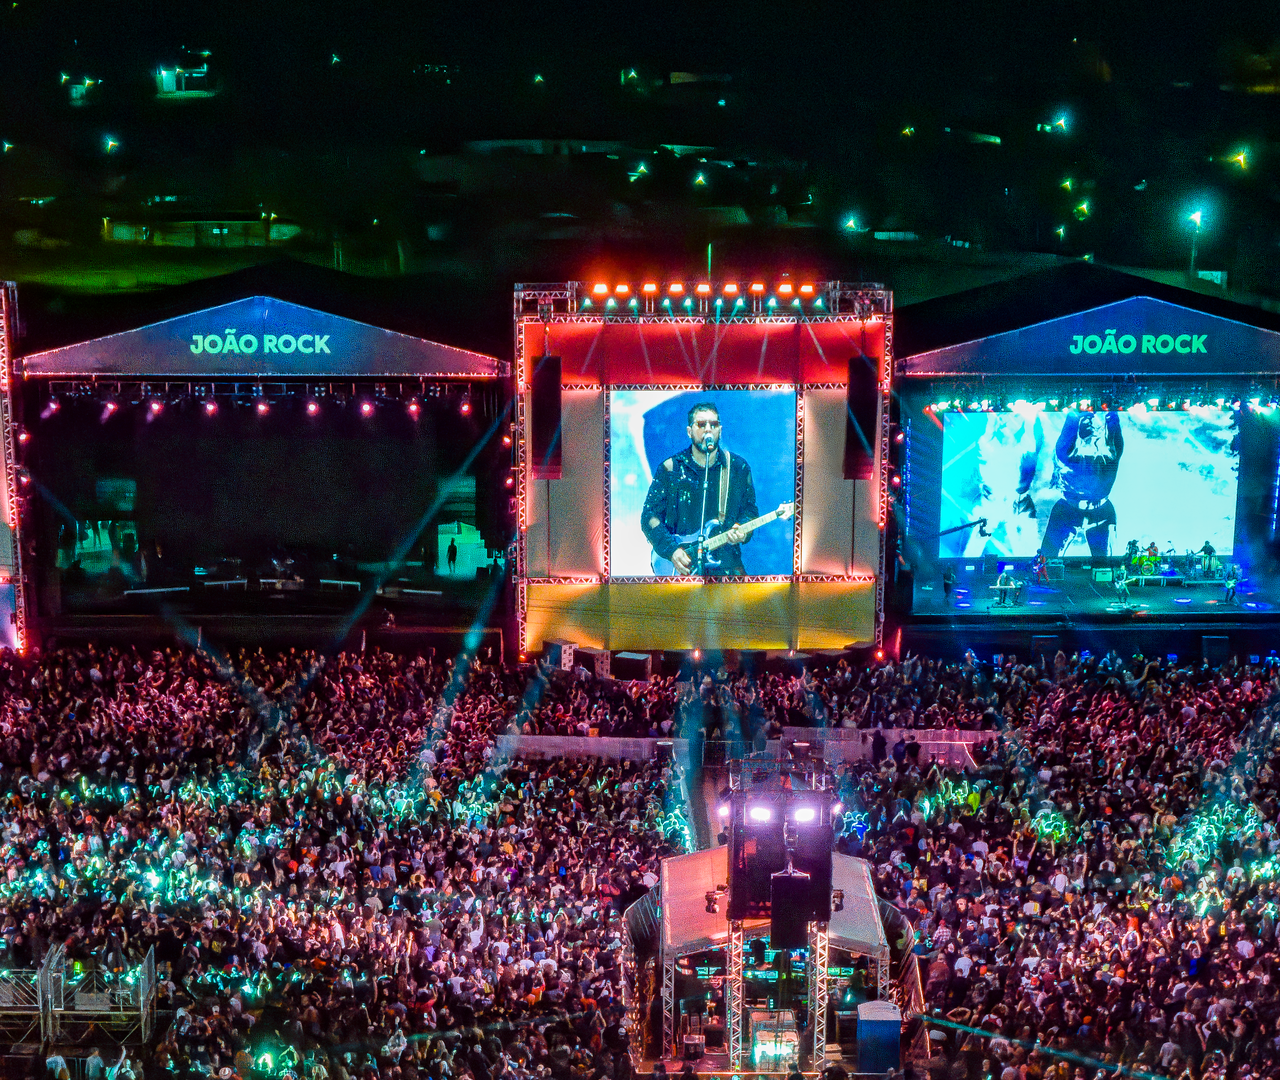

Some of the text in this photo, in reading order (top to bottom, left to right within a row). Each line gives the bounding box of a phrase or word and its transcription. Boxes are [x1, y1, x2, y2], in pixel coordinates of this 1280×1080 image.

[190, 328, 331, 354] JOÃO ROCK
[1070, 328, 1208, 354] JOÃO ROCK
